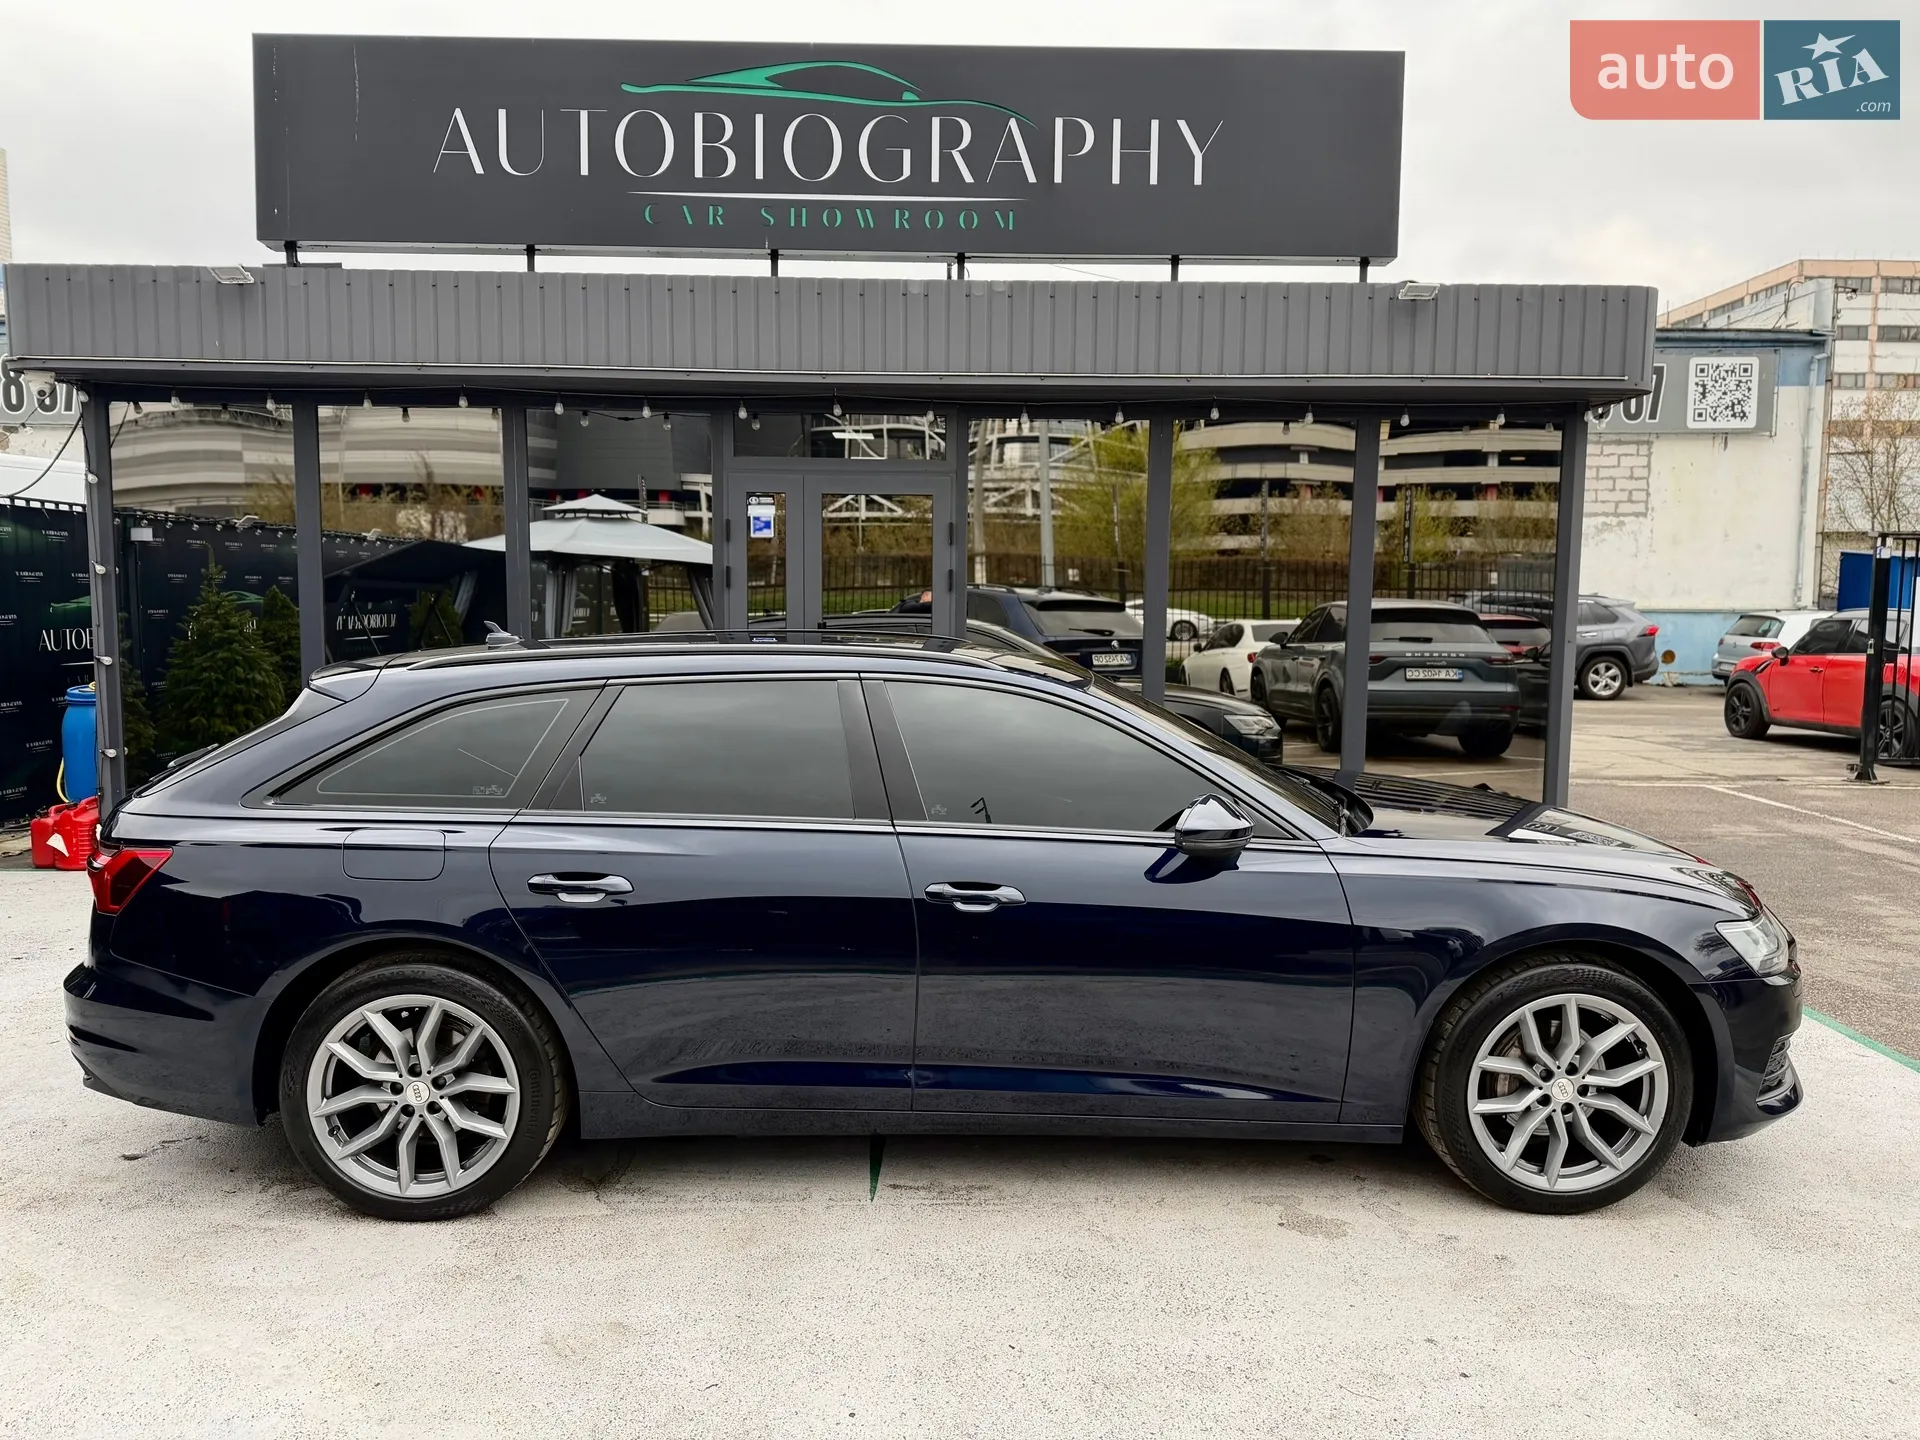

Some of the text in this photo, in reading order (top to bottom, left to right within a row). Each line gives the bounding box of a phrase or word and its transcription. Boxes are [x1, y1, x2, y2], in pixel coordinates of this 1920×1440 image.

[433, 107, 1224, 186] AUTOBIOGRAPHY
[644, 203, 1014, 231] CAR SHOWROOM
